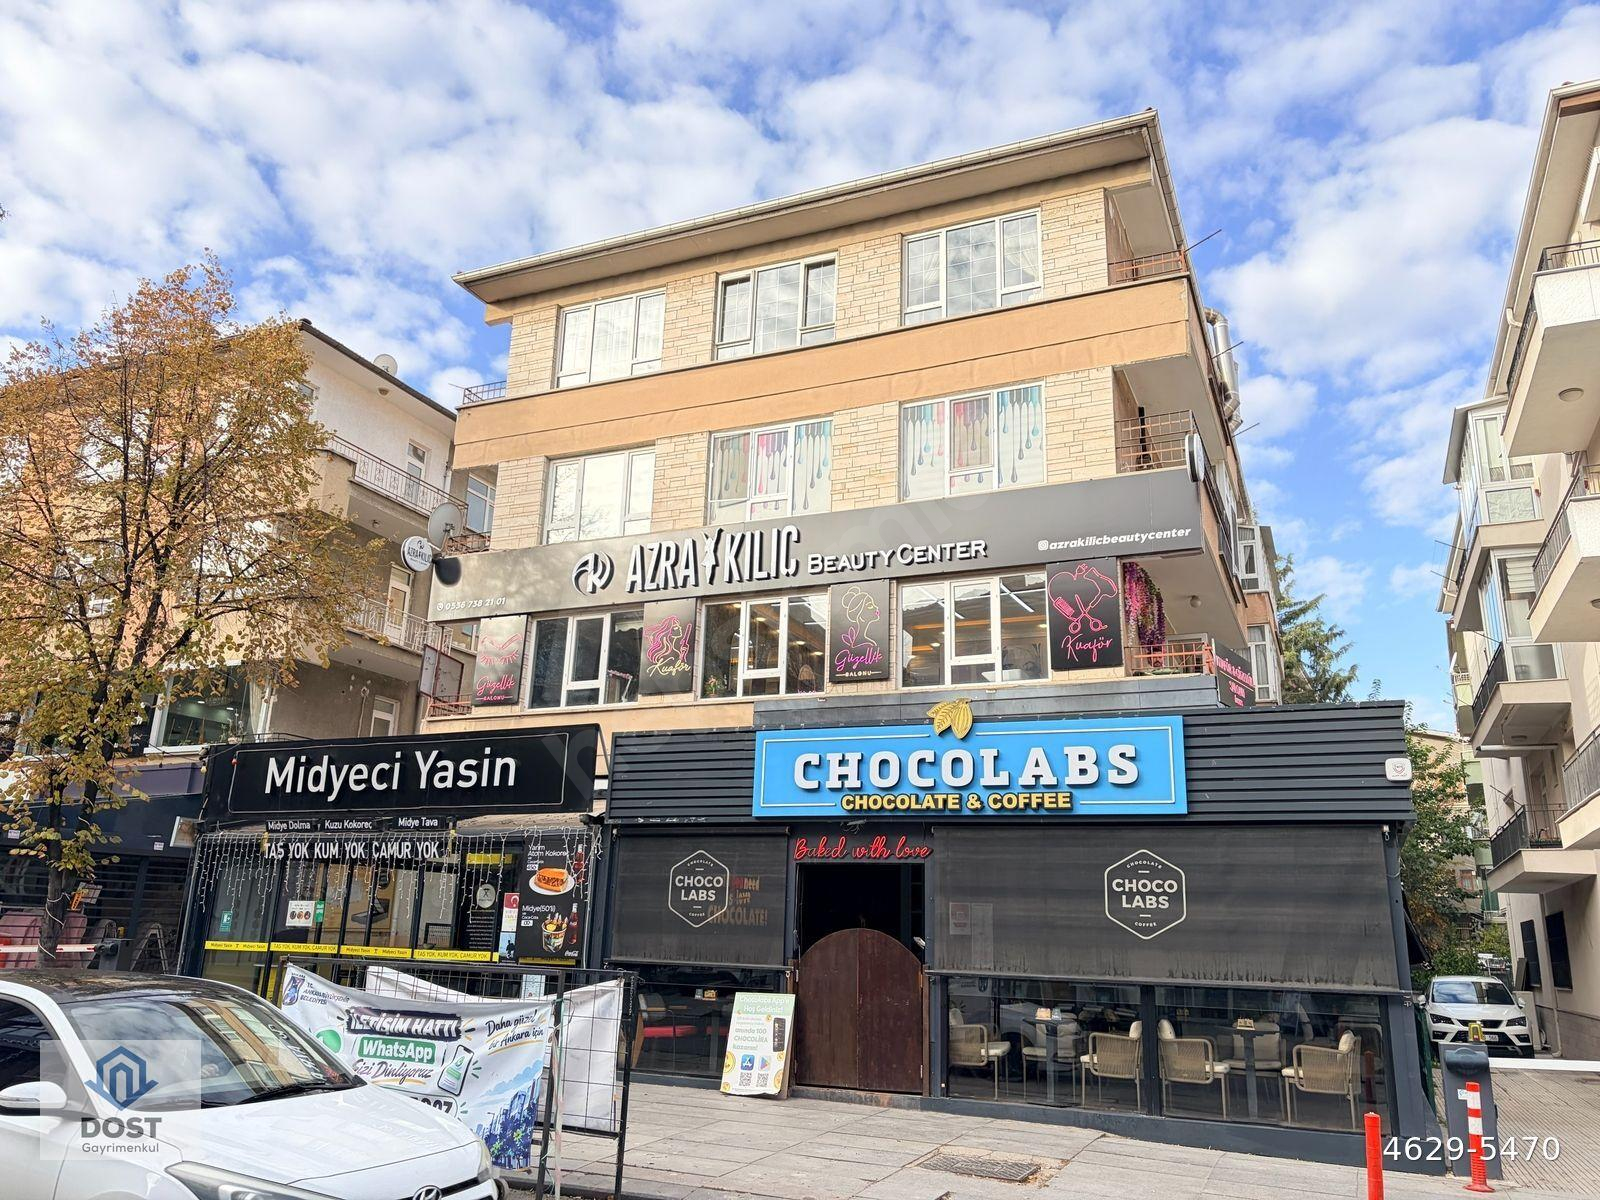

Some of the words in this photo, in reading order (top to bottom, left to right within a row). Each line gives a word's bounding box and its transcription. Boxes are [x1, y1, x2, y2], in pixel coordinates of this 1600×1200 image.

[625, 537, 698, 593] AZRA
[723, 524, 801, 584] KILIÇ
[467, 600, 483, 608] 738
[485, 598, 494, 606] 21
[496, 597, 506, 605] 01
[1061, 635, 1113, 663] Kuaför
[646, 657, 691, 678] Kuaför
[835, 647, 884, 672] Güzellik
[476, 675, 516, 696] Güzellik
[265, 751, 401, 802] Midyeci
[415, 747, 517, 791] Yasin
[794, 744, 1140, 790] CHOCOLABS
[841, 793, 961, 812] CHOCOLATE
[965, 793, 984, 811] &
[988, 791, 1073, 811] COFFEE
[268, 821, 287, 832] Midye
[289, 820, 311, 830] Dolma
[324, 819, 343, 829] Kuzu
[344, 819, 373, 830] Kokoreç
[398, 817, 420, 829] Midye
[421, 817, 438, 827] Tava
[288, 842, 310, 859] YOK
[314, 842, 339, 859] KUM
[345, 842, 366, 859] YOK
[372, 841, 412, 860] ÇAMUR
[416, 841, 439, 859] YOK
[793, 836, 848, 860] Baked
[851, 836, 891, 859] with
[895, 835, 934, 858] love
[1126, 860, 1162, 869] CHOCOLATE
[675, 875, 724, 887] CHOCO
[1112, 878, 1178, 893] CHOCO
[681, 889, 716, 901] LABS
[1121, 895, 1170, 909] LABS
[411, 1018, 458, 1037] HATTI
[485, 1016, 512, 1037] Daha
[500, 1030, 530, 1047] Ankara
[363, 1039, 433, 1063] WhatsApp
[371, 1060, 434, 1085] Dinliyoruz
